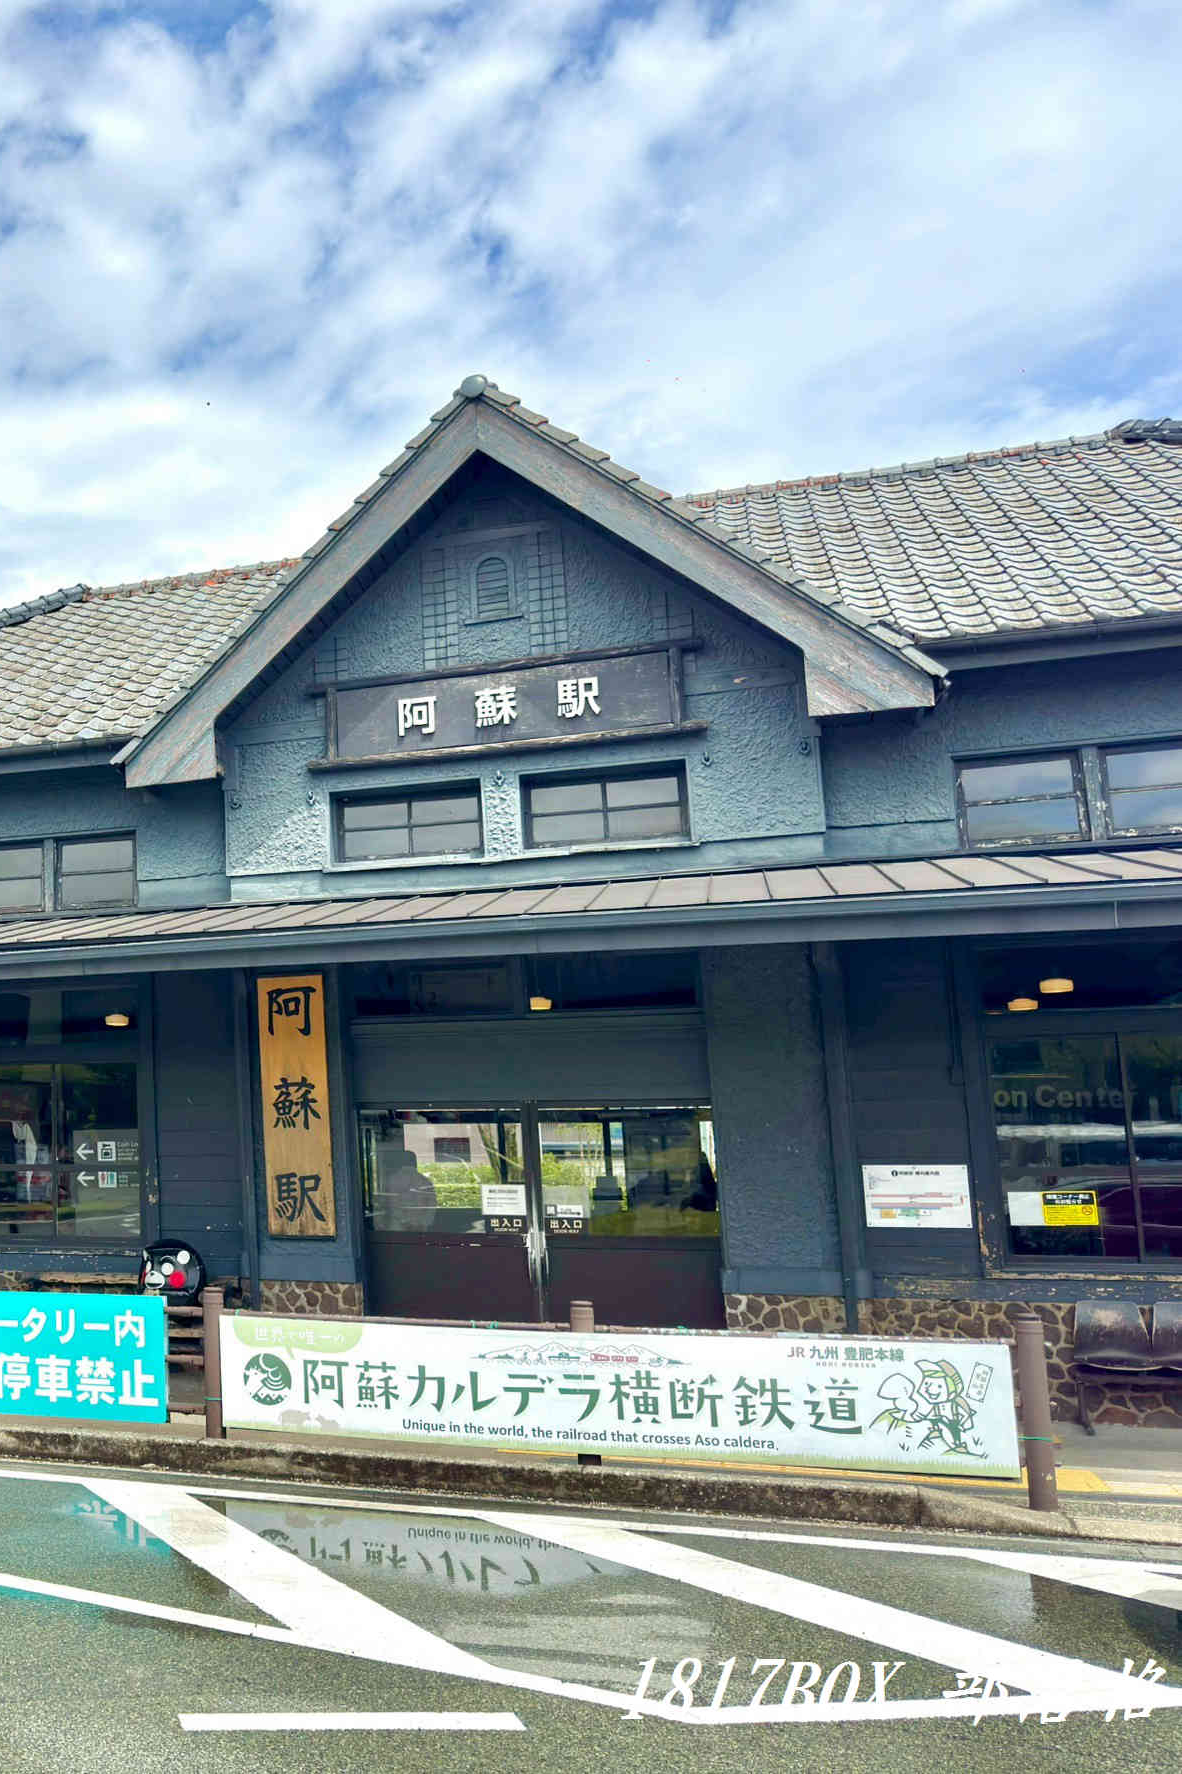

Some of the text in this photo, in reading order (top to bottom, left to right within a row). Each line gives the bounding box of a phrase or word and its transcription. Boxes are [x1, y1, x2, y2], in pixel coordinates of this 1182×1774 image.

[397, 676, 601, 737] 阿蘇駅
[266, 985, 327, 1226] 阿蘇駅
[490, 1218, 523, 1228] 出入口
[550, 1219, 583, 1229] 出入口
[786, 1345, 806, 1358] JR
[809, 1345, 839, 1360] 九州
[302, 1359, 864, 1435] 阿蘇カルデラ横断鉄道
[402, 1418, 446, 1435] Unique
[449, 1421, 461, 1432] in
[464, 1423, 485, 1435] the
[488, 1425, 528, 1439] world,
[532, 1427, 553, 1439] the
[556, 1428, 607, 1442] railroad
[611, 1431, 638, 1443] that
[642, 1434, 691, 1446] crosses
[695, 1434, 720, 1447] Aso
